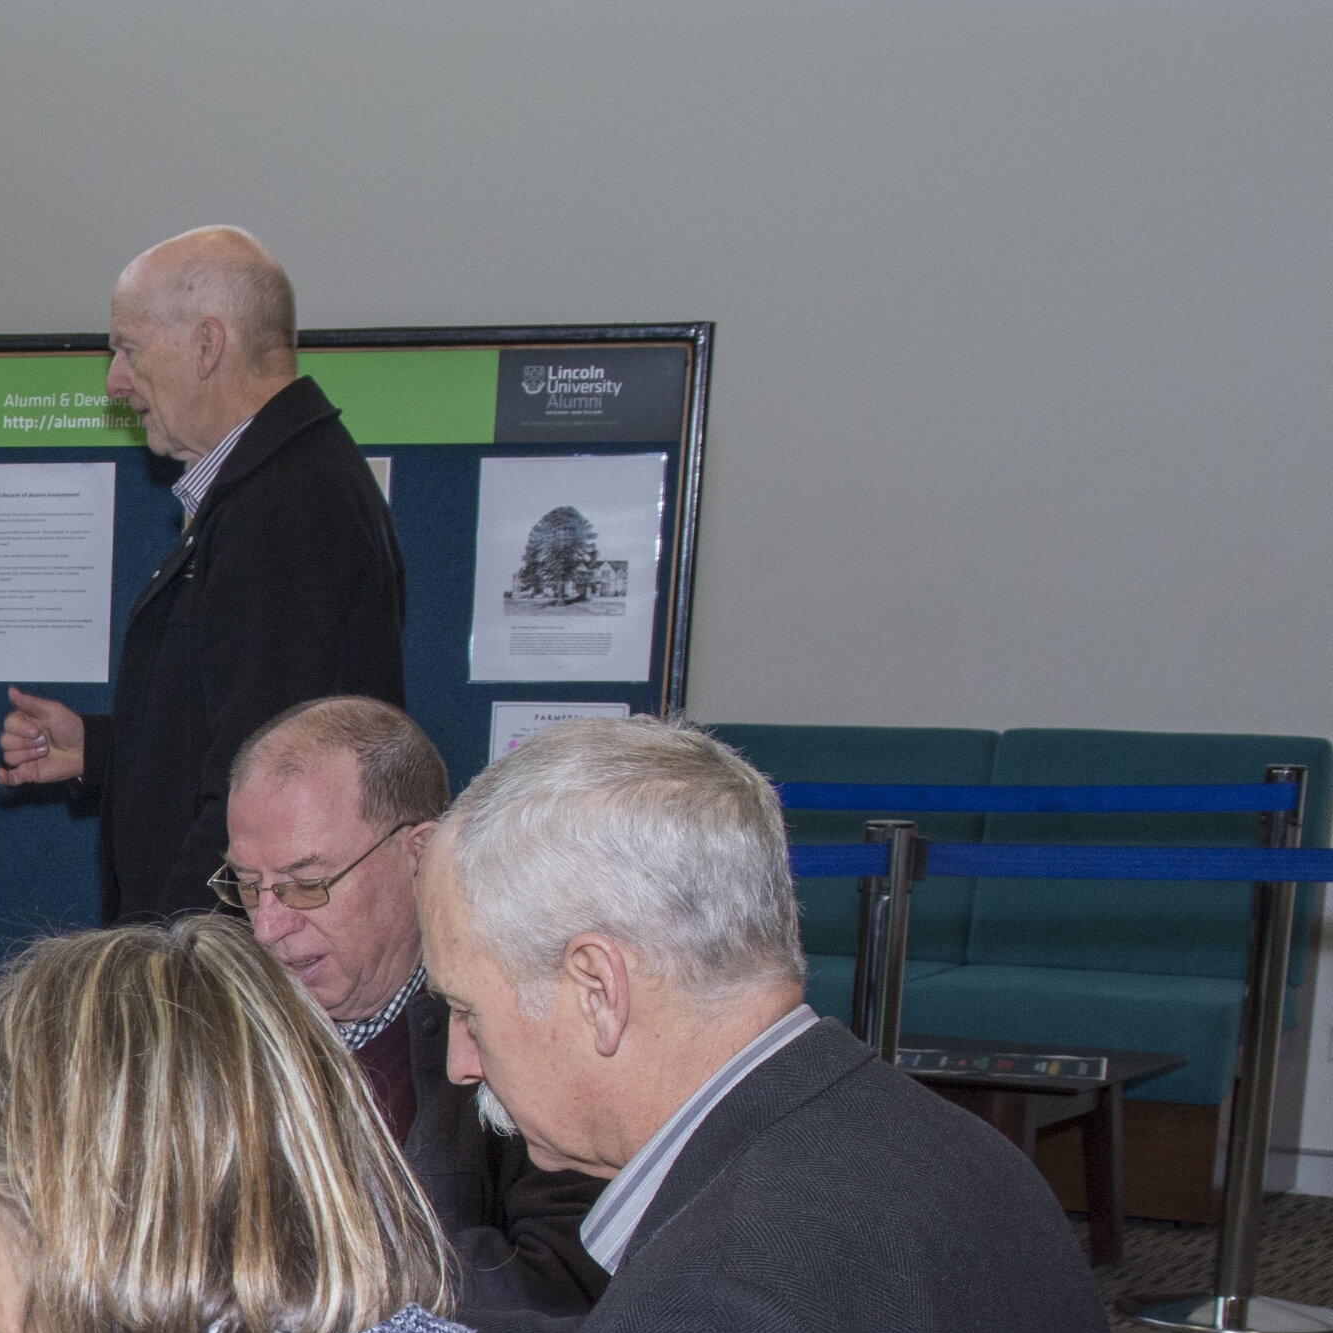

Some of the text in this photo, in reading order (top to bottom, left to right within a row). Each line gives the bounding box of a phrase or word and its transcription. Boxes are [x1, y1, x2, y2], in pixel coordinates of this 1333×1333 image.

[548, 365, 604, 379] Lincoln
[547, 379, 622, 396] University
[3, 393, 130, 409] Alumni & Develop
[547, 394, 602, 408] Alumni
